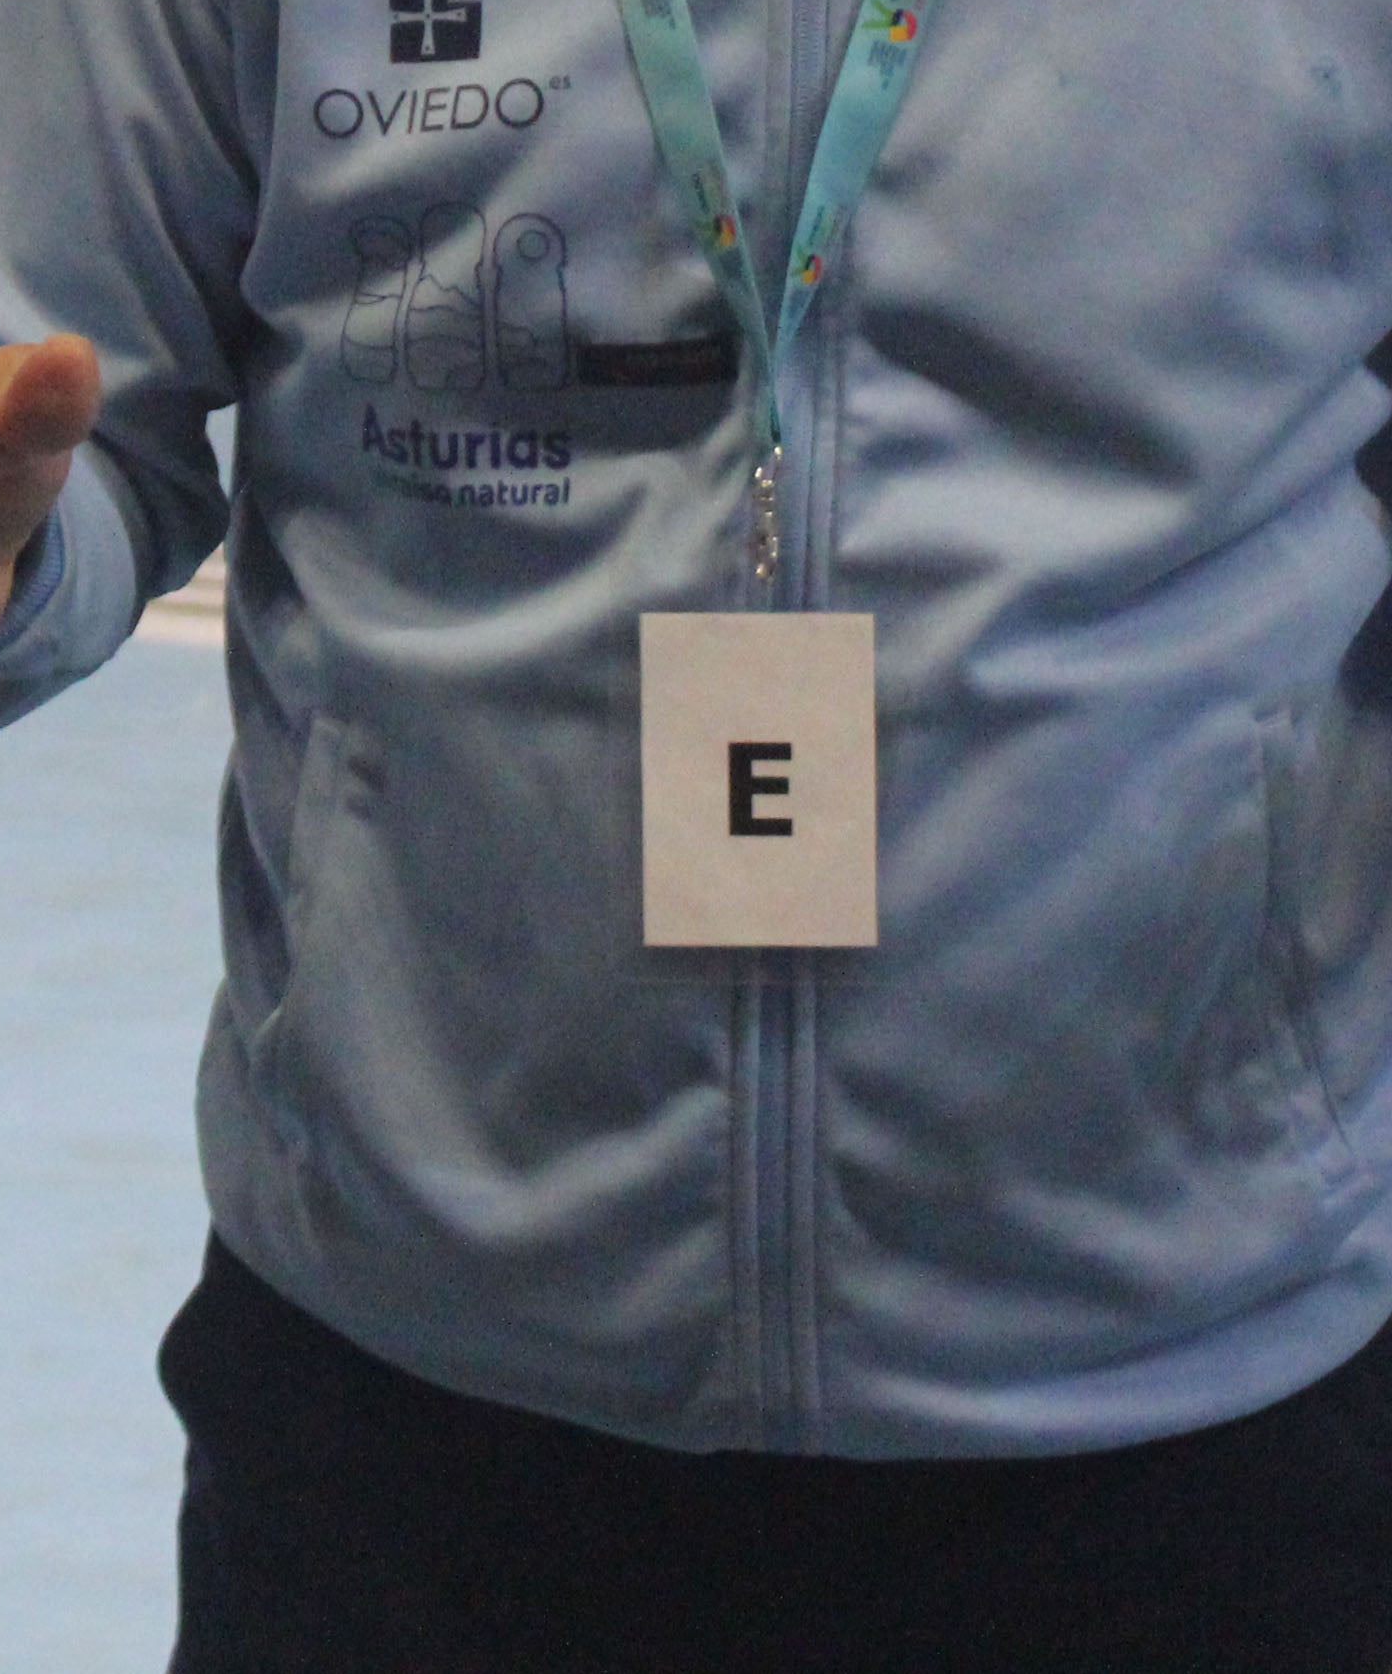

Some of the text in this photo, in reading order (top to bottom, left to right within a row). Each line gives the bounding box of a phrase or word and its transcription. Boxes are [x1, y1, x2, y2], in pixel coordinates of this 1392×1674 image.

[362, 403, 572, 470] Asturias
[458, 476, 571, 507] natural
[727, 742, 793, 837] E
